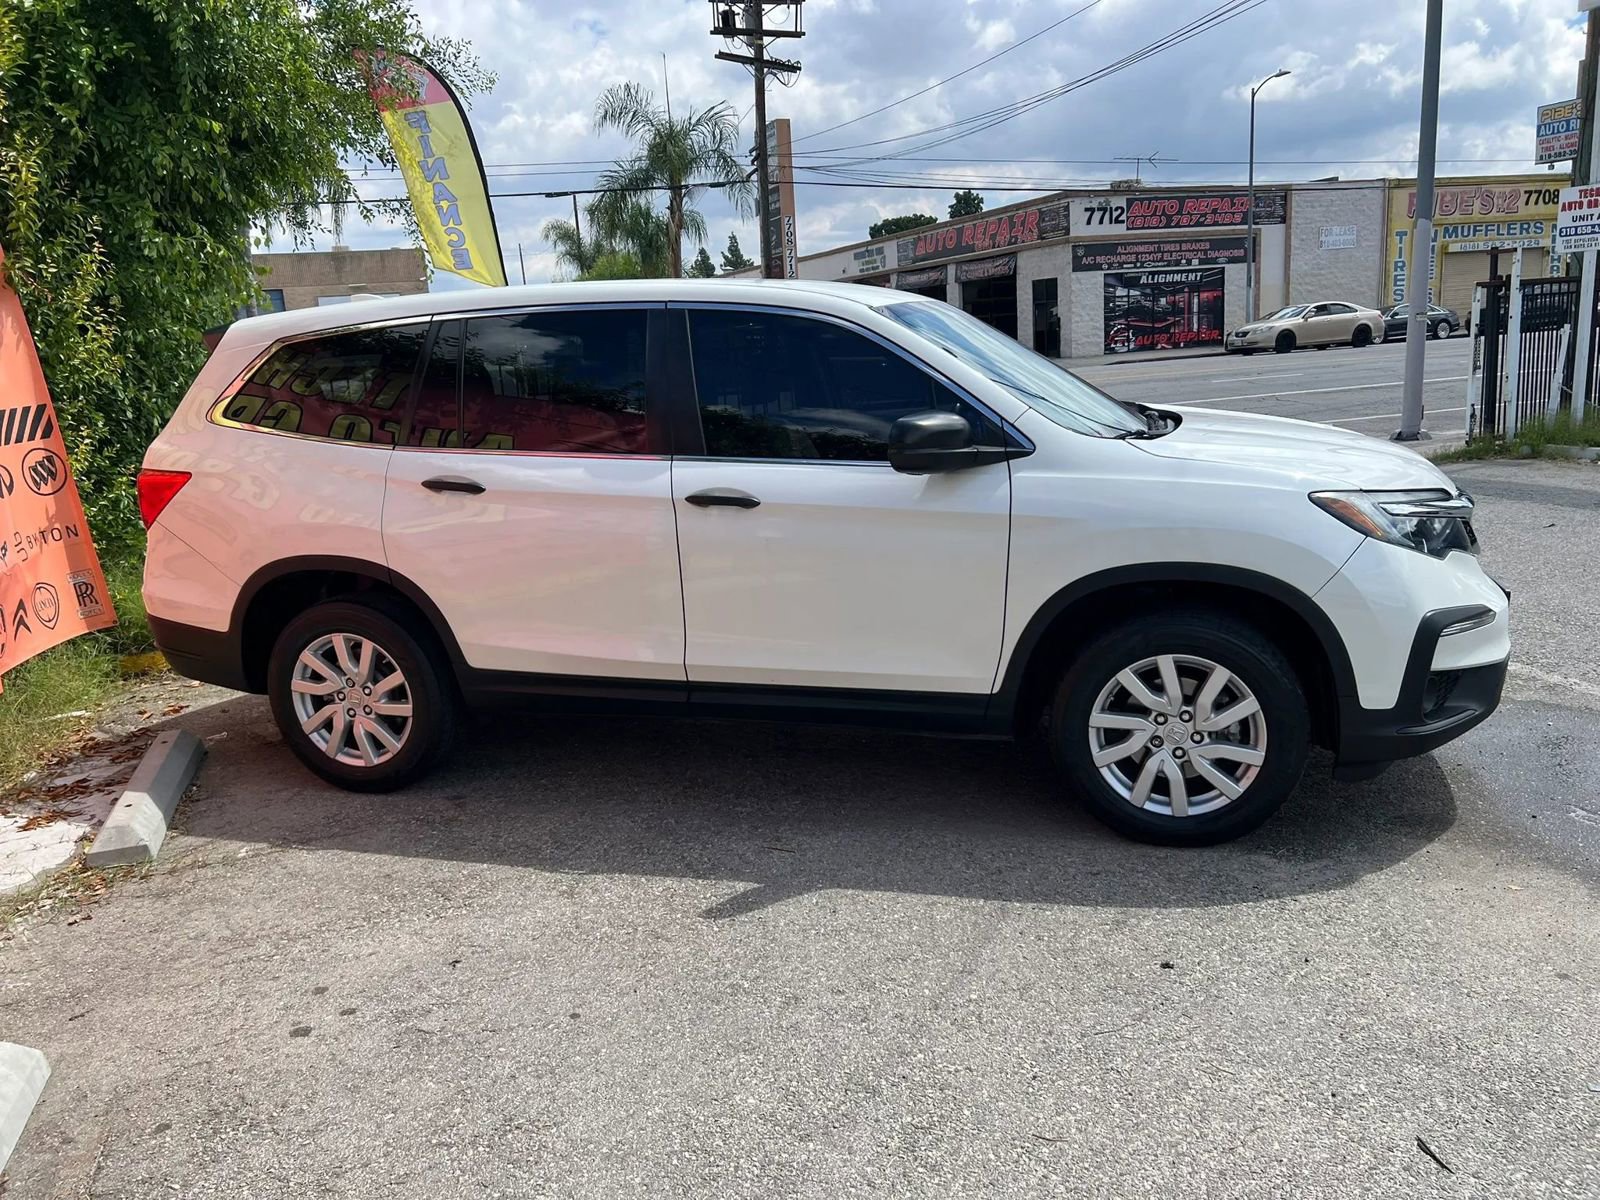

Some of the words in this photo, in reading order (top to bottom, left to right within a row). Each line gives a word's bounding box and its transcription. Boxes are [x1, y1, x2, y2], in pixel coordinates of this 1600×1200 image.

[1540, 121, 1566, 136] AUTO
[1524, 188, 1560, 206] 7708
[1084, 205, 1126, 226] 7712
[1127, 199, 1180, 217] AUTO
[1561, 200, 1584, 212] AUTO
[1572, 214, 1595, 222] UNIT
[784, 215, 794, 246] 7708
[915, 228, 957, 256] AUTO
[961, 209, 1040, 246] REPAIR
[1442, 221, 1544, 239] MUFFLERS
[1560, 227, 1576, 236] 310
[1577, 225, 1600, 236] 650-4
[1116, 244, 1159, 254] ALIGNMENT
[1160, 243, 1180, 252] TIRES
[1182, 242, 1210, 251] BRAKES
[786, 248, 796, 278] 7712
[1081, 256, 1095, 265] A/C
[1096, 254, 1137, 264] RECHARGE
[1164, 250, 1206, 260] ELECTRICAL
[1207, 249, 1245, 258] DIAGNOSIS
[1393, 230, 1408, 303] TIRES
[1139, 272, 1203, 284] ALIGNMENT
[1136, 333, 1168, 347] AUTO
